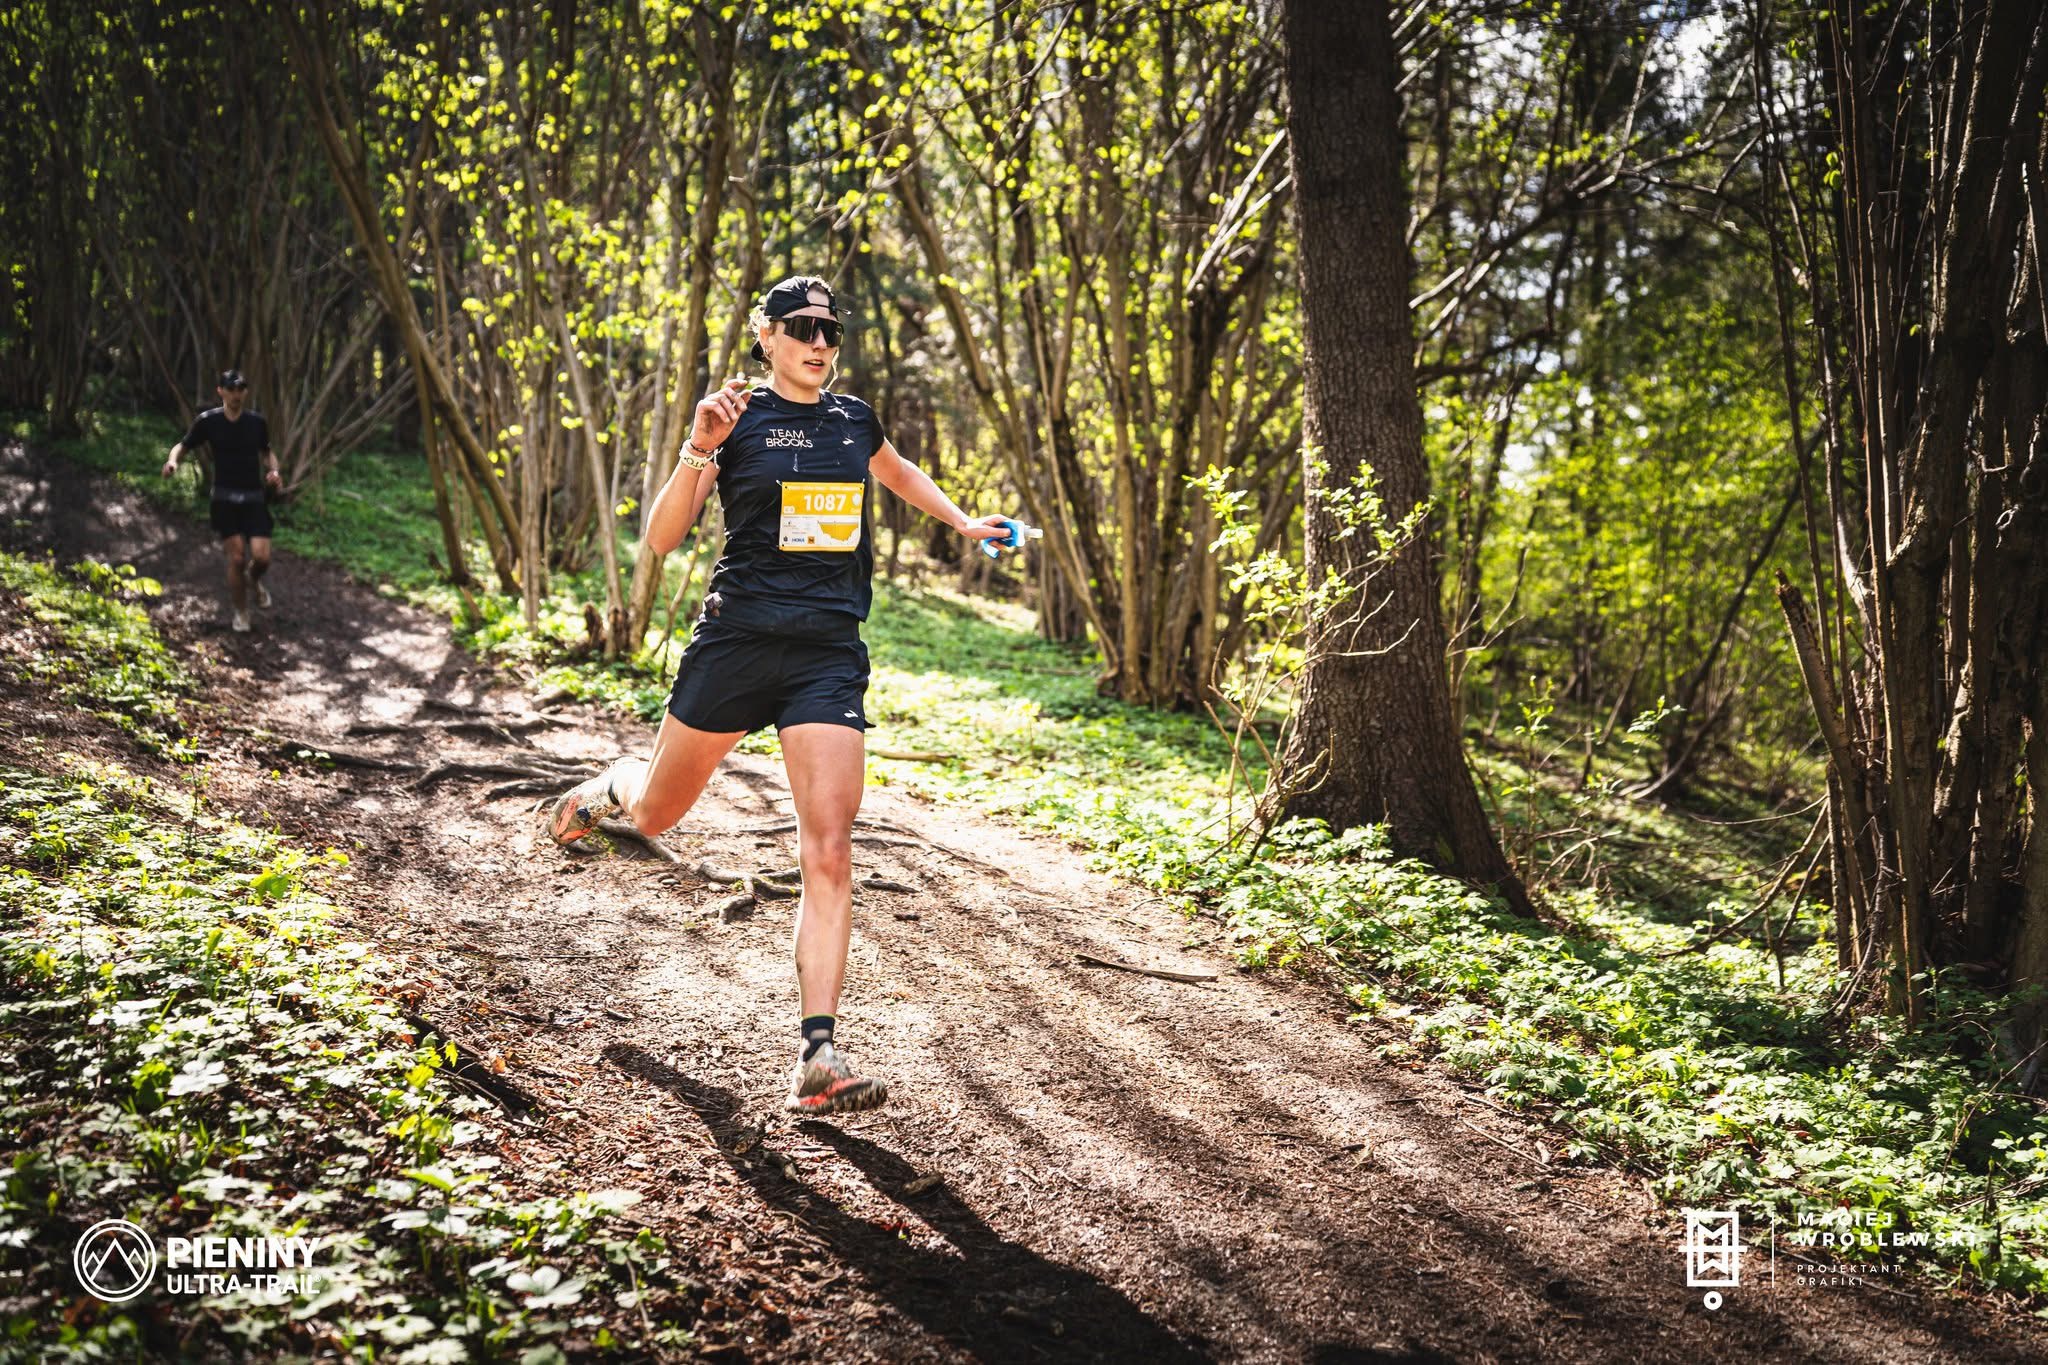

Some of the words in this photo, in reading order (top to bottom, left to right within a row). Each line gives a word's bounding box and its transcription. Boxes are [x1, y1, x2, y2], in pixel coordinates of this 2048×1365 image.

[769, 428, 805, 439] TEAM
[765, 437, 813, 448] BROOKS
[803, 493, 847, 512] 1087
